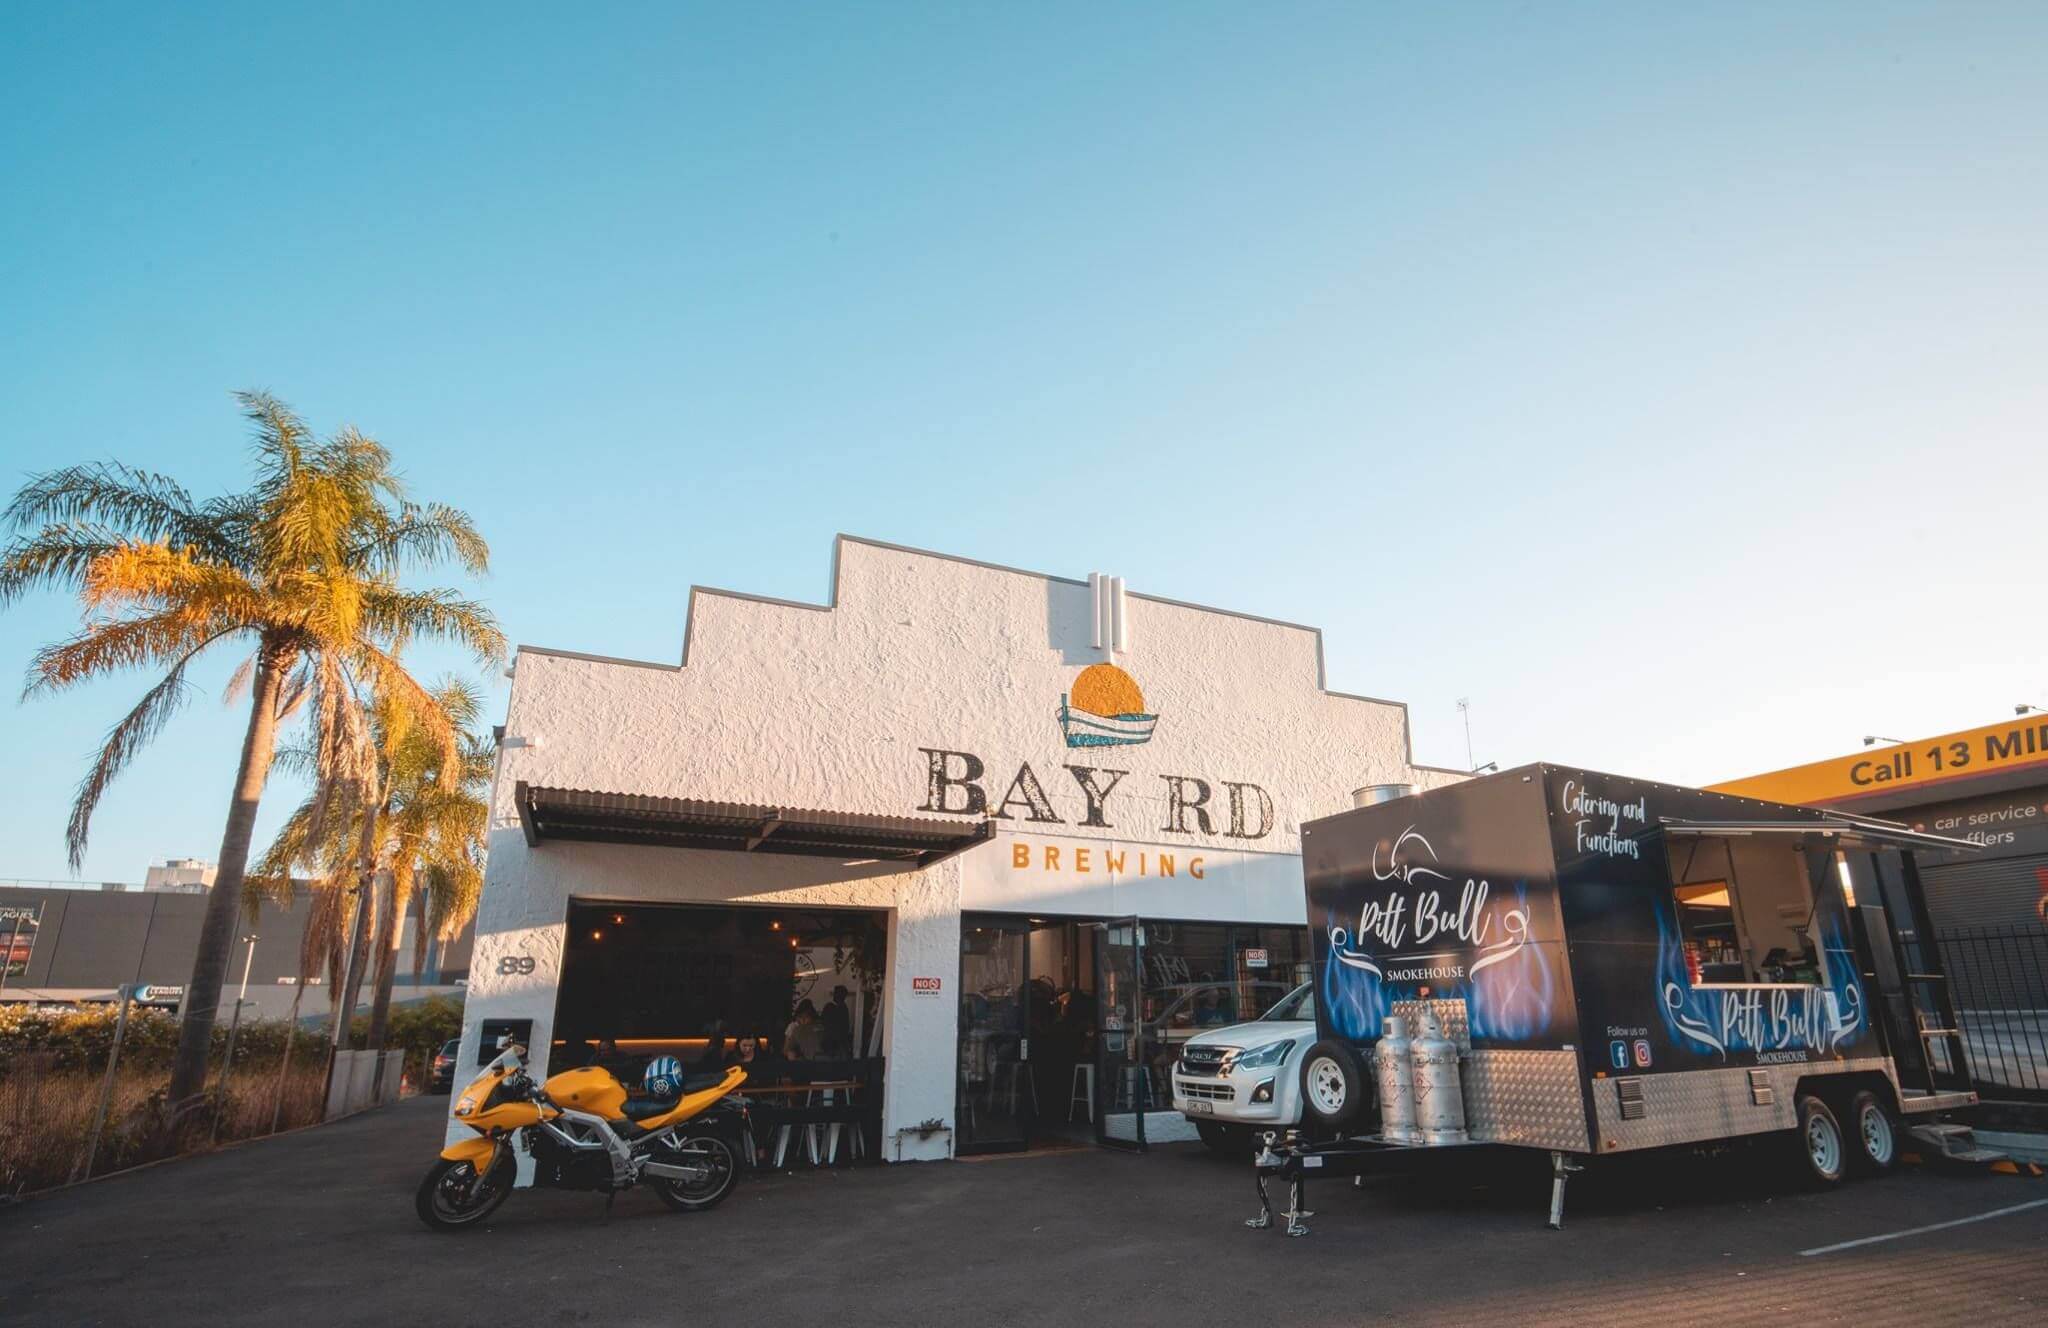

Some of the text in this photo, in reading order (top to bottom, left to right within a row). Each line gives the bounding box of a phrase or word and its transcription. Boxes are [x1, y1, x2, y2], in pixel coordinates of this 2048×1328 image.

[1850, 751, 1912, 785] Call
[1926, 741, 1971, 771] 13
[916, 747, 1275, 840] BAY RD
[1562, 780, 1646, 830] Catering and
[1935, 805, 2037, 830] car service
[1575, 819, 1639, 860] Functions
[1011, 843, 1205, 880] BREWING
[1358, 879, 1492, 949] Pitt Bull
[498, 956, 536, 976] 89
[915, 979, 929, 988] NO
[1387, 966, 1464, 981] SMOKEHOUSE
[1607, 1025, 1648, 1037] Follow us on
[1722, 987, 1826, 1055] Pitt Bull
[1756, 1050, 1809, 1065] SMOKEHOUSE
